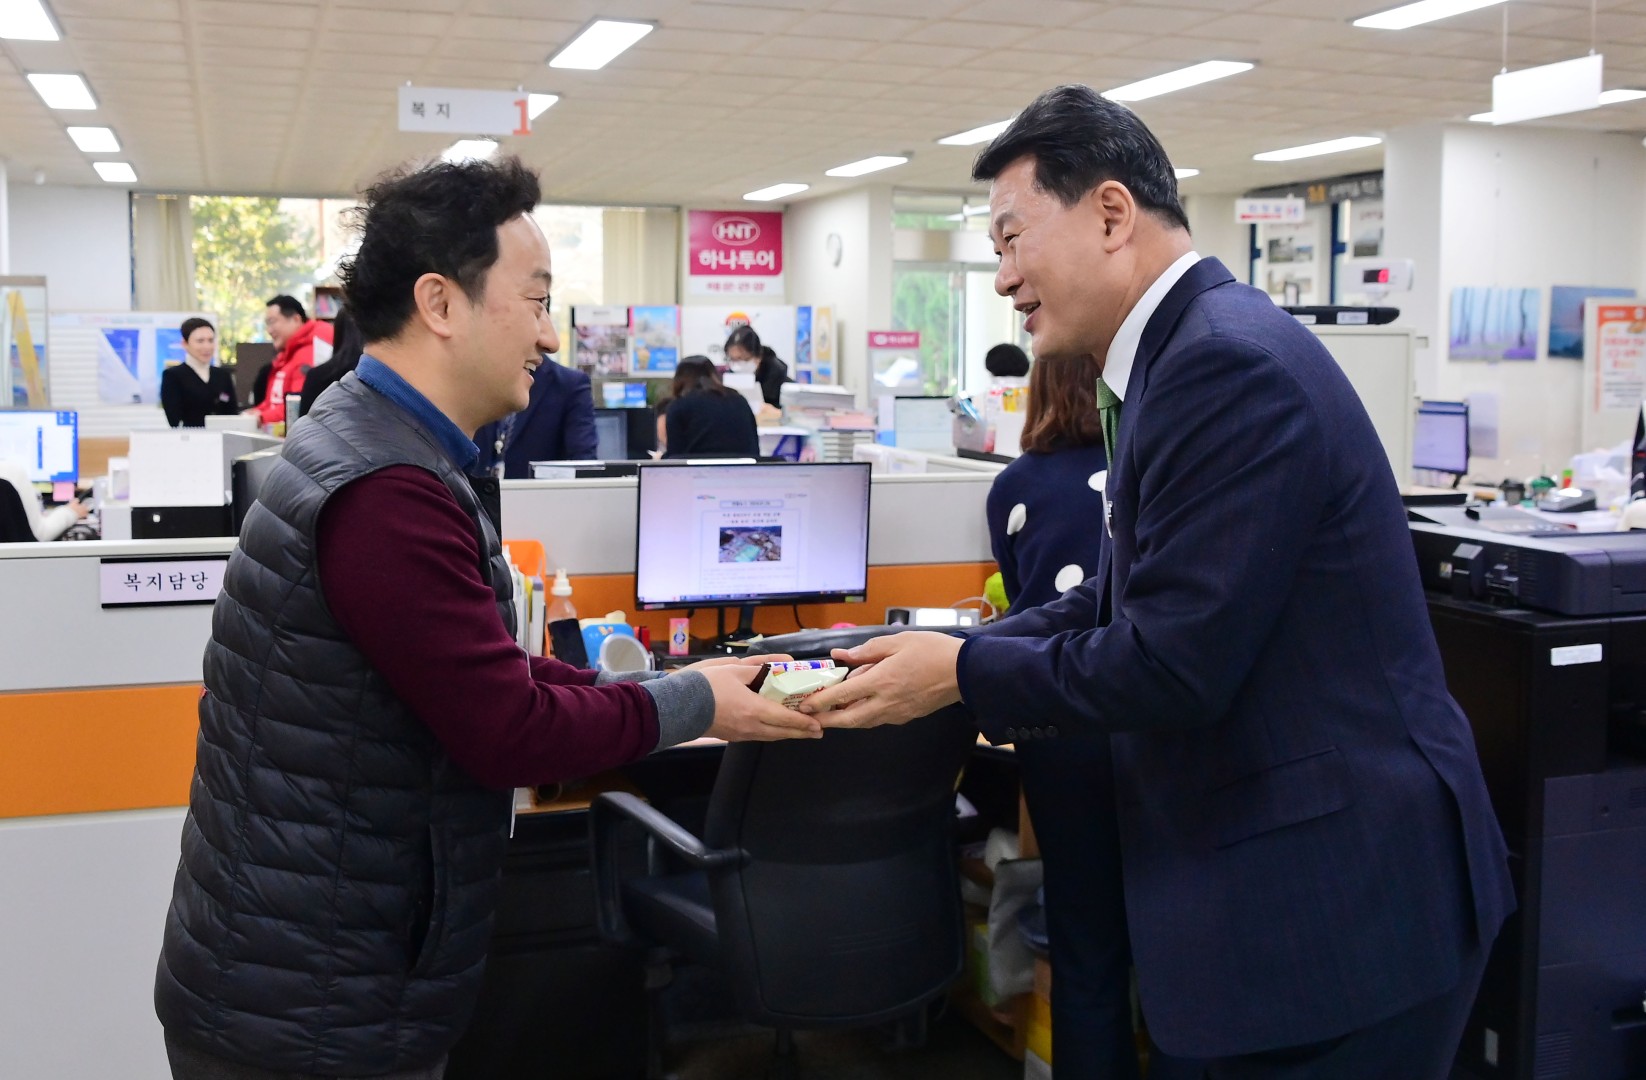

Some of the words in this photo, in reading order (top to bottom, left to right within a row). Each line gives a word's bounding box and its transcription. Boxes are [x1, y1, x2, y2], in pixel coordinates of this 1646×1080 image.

[512, 99, 531, 136] 1
[718, 223, 755, 240] HNT
[699, 248, 776, 271] 하나투어
[124, 571, 208, 592] 복지담당
